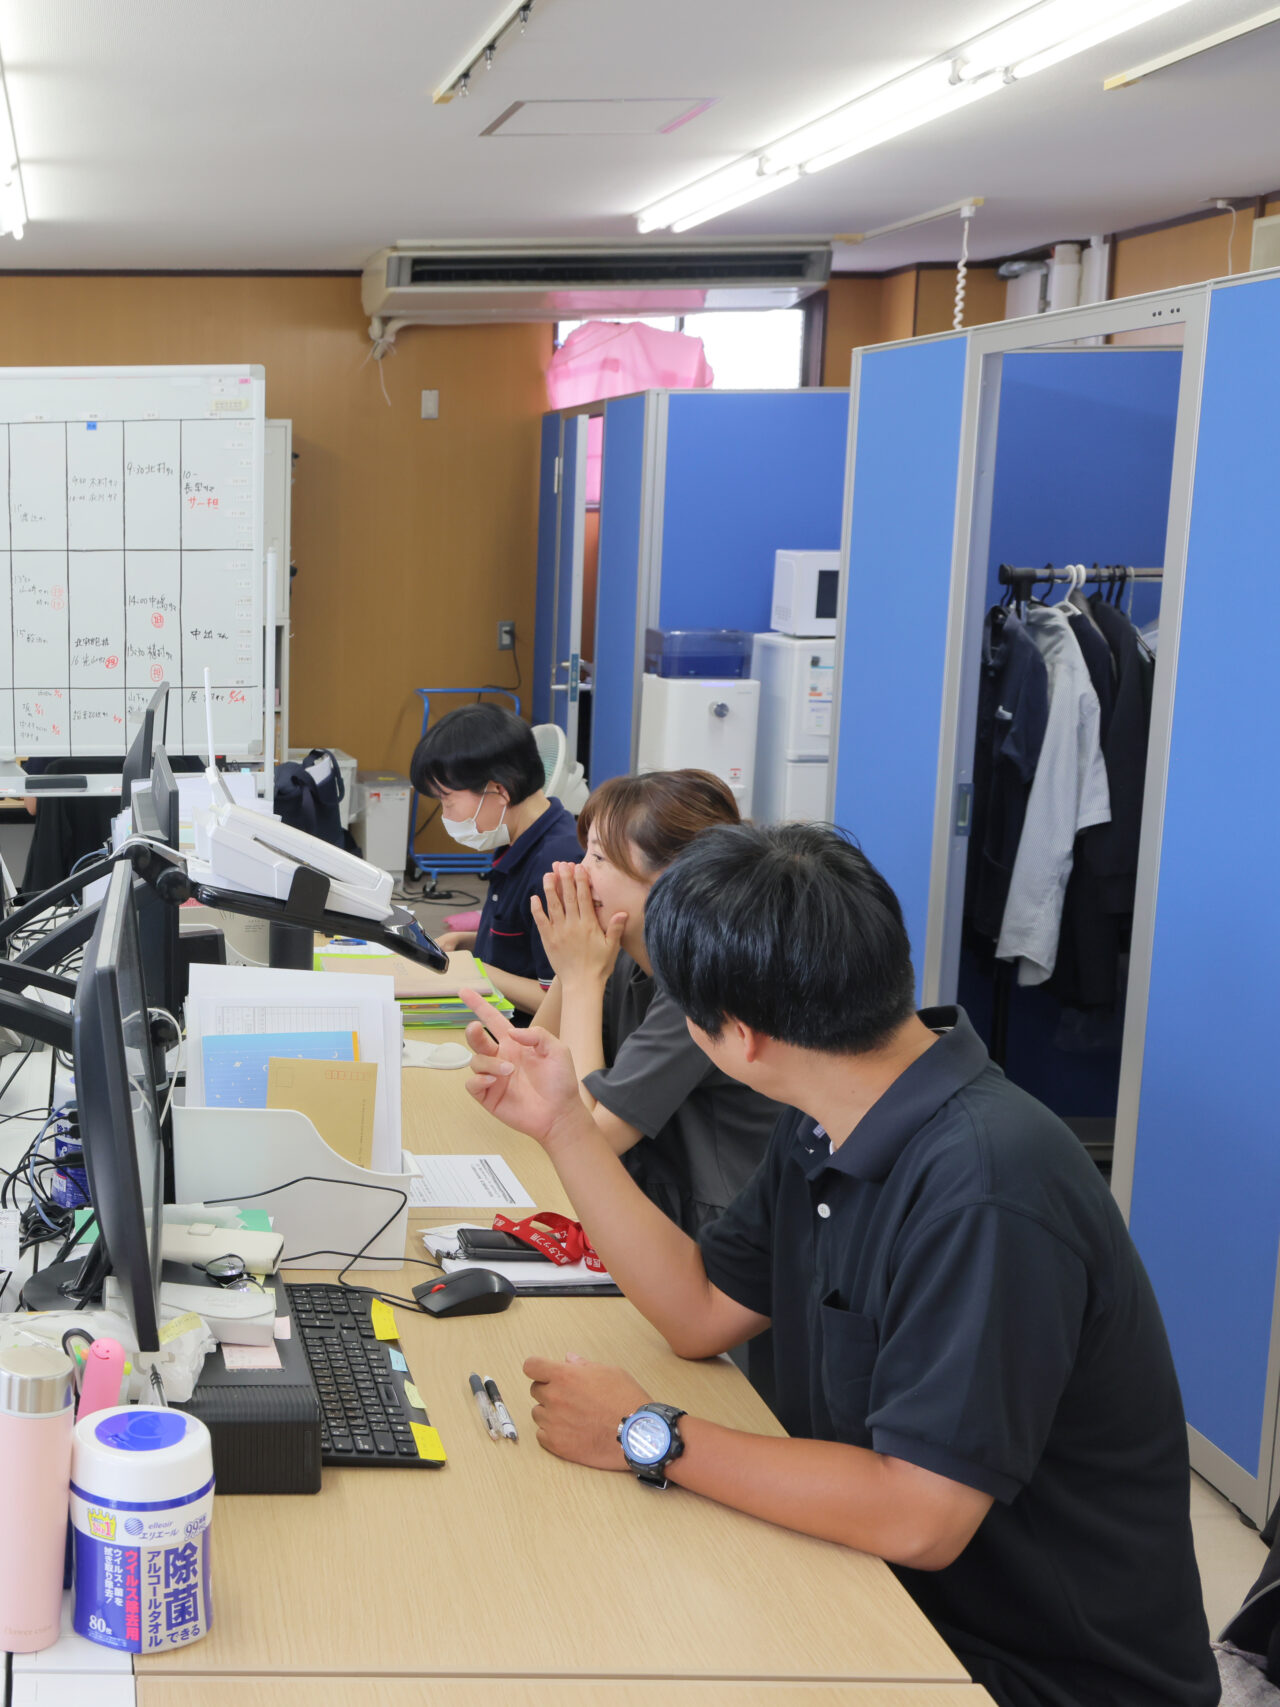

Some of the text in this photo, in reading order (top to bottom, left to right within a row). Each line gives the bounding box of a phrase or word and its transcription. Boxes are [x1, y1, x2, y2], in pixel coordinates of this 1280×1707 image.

[148, 1521, 173, 1530] elleair
[139, 1529, 180, 1540] エリエール
[164, 1541, 199, 1631] 除菌
[147, 1550, 162, 1648] アルコールタオル
[167, 1626, 201, 1643] できる
